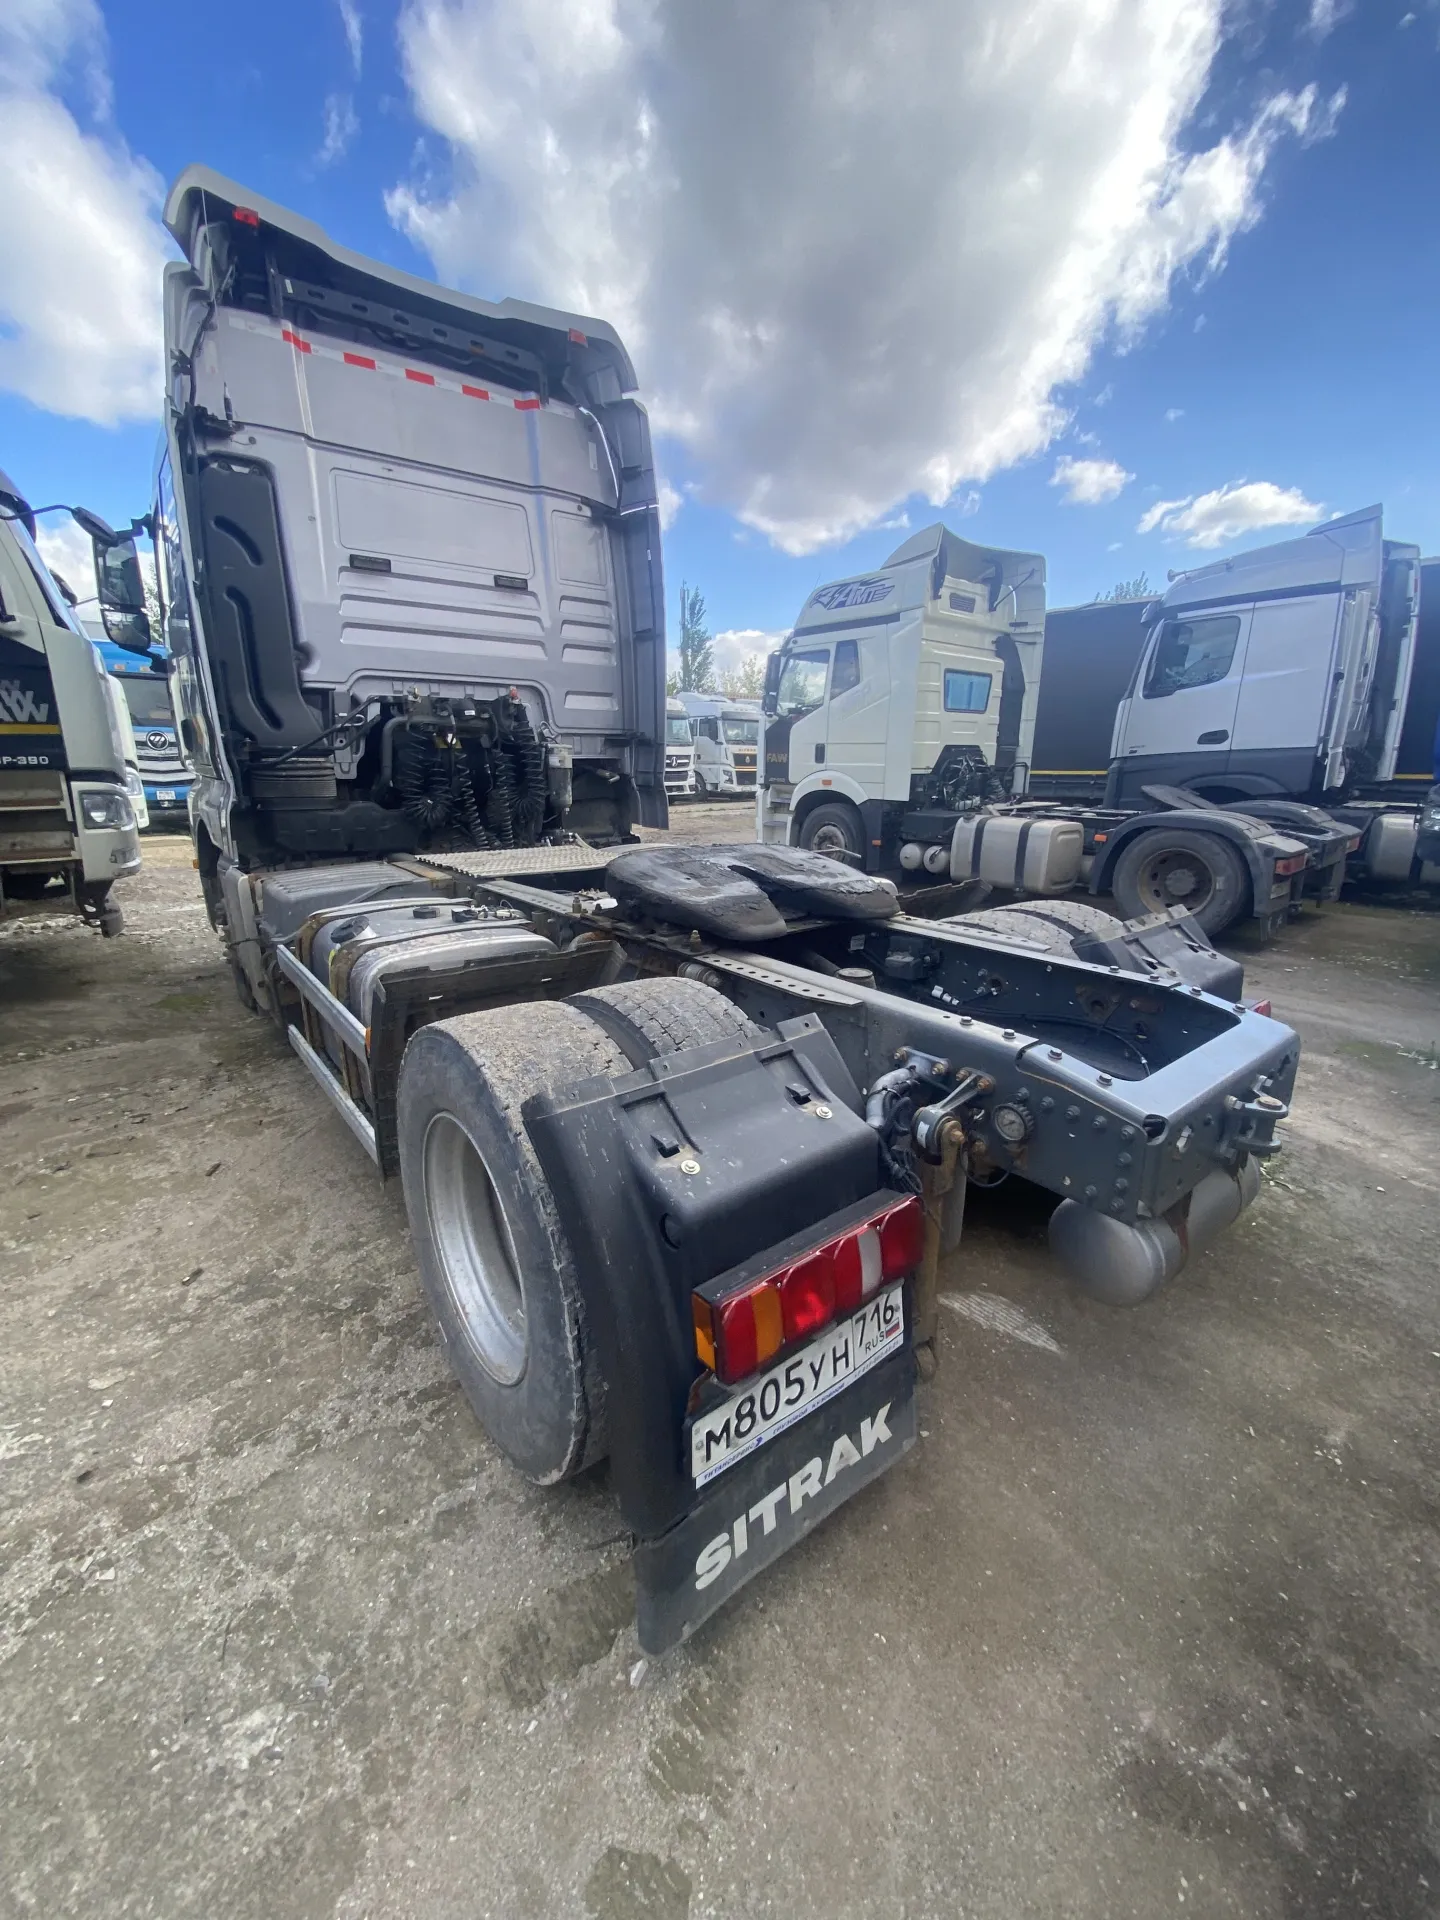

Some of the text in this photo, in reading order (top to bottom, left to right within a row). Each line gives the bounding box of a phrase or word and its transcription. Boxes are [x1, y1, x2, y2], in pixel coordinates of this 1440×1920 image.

[0, 756, 49, 765] P-390
[766, 753, 788, 763] FAW
[855, 1293, 894, 1348] 716
[865, 1330, 885, 1355] RUS
[695, 1402, 893, 1590] SITRAK
